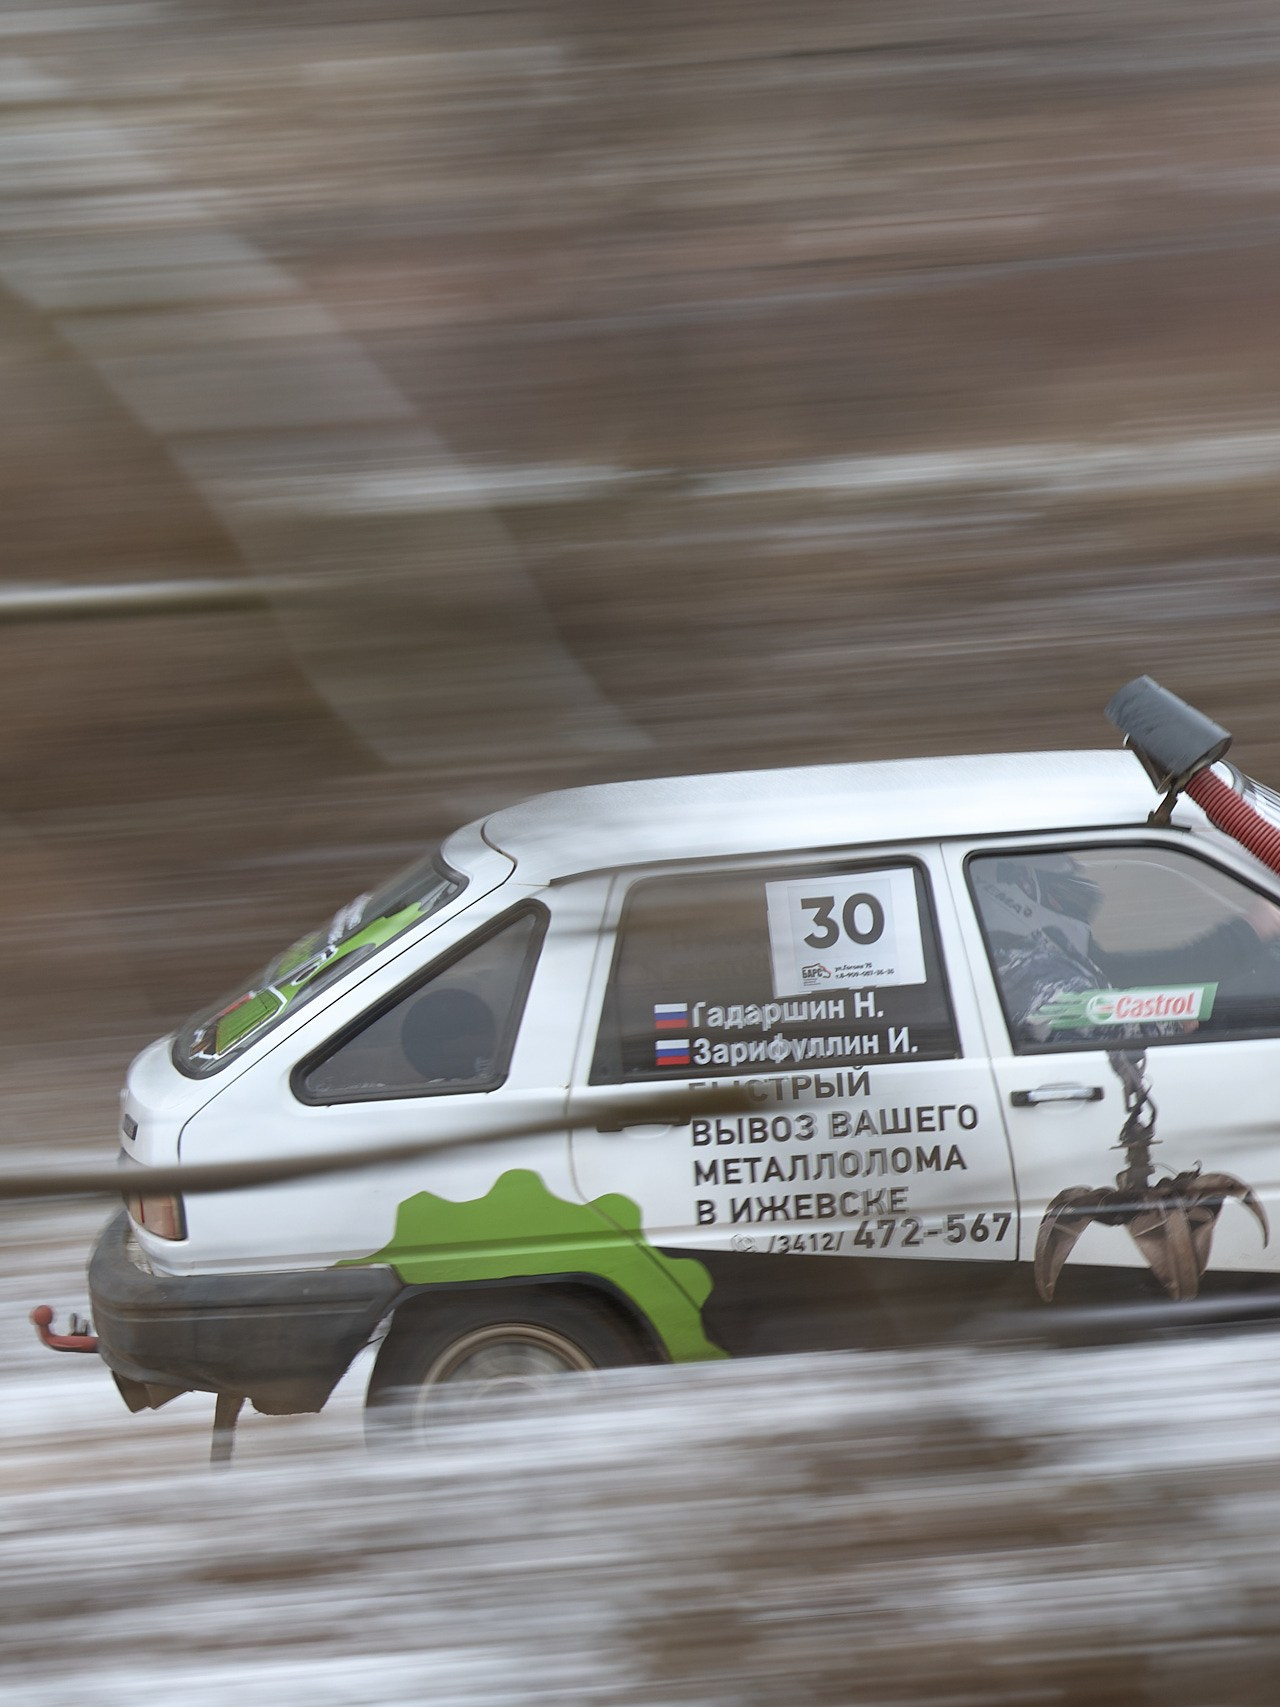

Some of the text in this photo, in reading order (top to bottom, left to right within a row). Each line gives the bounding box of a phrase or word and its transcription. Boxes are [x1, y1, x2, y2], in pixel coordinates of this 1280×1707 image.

[801, 892, 885, 949] 30
[802, 968, 823, 979] БАРС
[692, 991, 884, 1031] Гадаршин Н.
[1115, 991, 1196, 1020] Castrol
[693, 1026, 918, 1067] Зарифуллин И.
[692, 1104, 979, 1147] ВЫВОЗ ВАШЕГО
[693, 1144, 968, 1186] МЕТАЛЛОЛОМА
[696, 1186, 910, 1227] В ИЖЕВСКЕ
[853, 1212, 1013, 1250] 472-567
